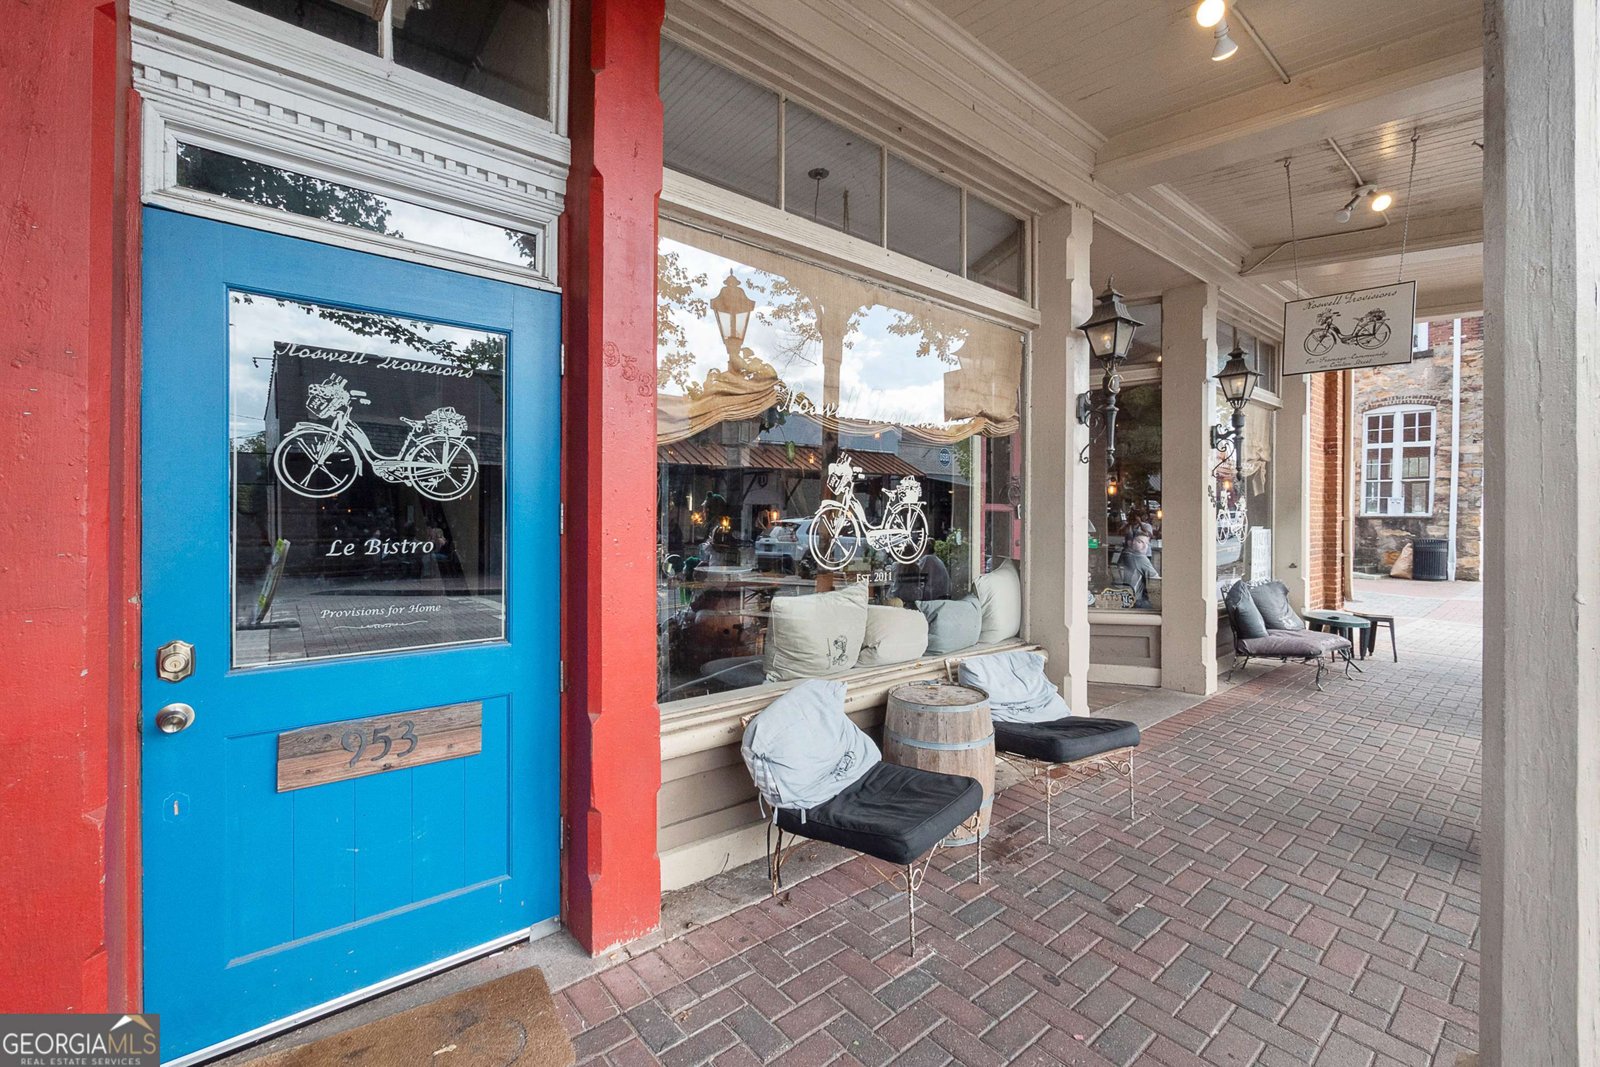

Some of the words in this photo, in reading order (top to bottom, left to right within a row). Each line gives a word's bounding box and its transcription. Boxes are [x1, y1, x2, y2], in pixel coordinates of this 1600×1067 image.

[275, 343, 368, 365] Roswell
[376, 354, 474, 379] Provisions
[604, 341, 654, 397] 953
[325, 539, 355, 557] Le
[363, 537, 434, 556] Bistro
[874, 572, 892, 582] 2011
[320, 606, 384, 619] Provisions
[385, 604, 405, 617] for
[407, 603, 441, 614] Home
[340, 720, 418, 768] 953
